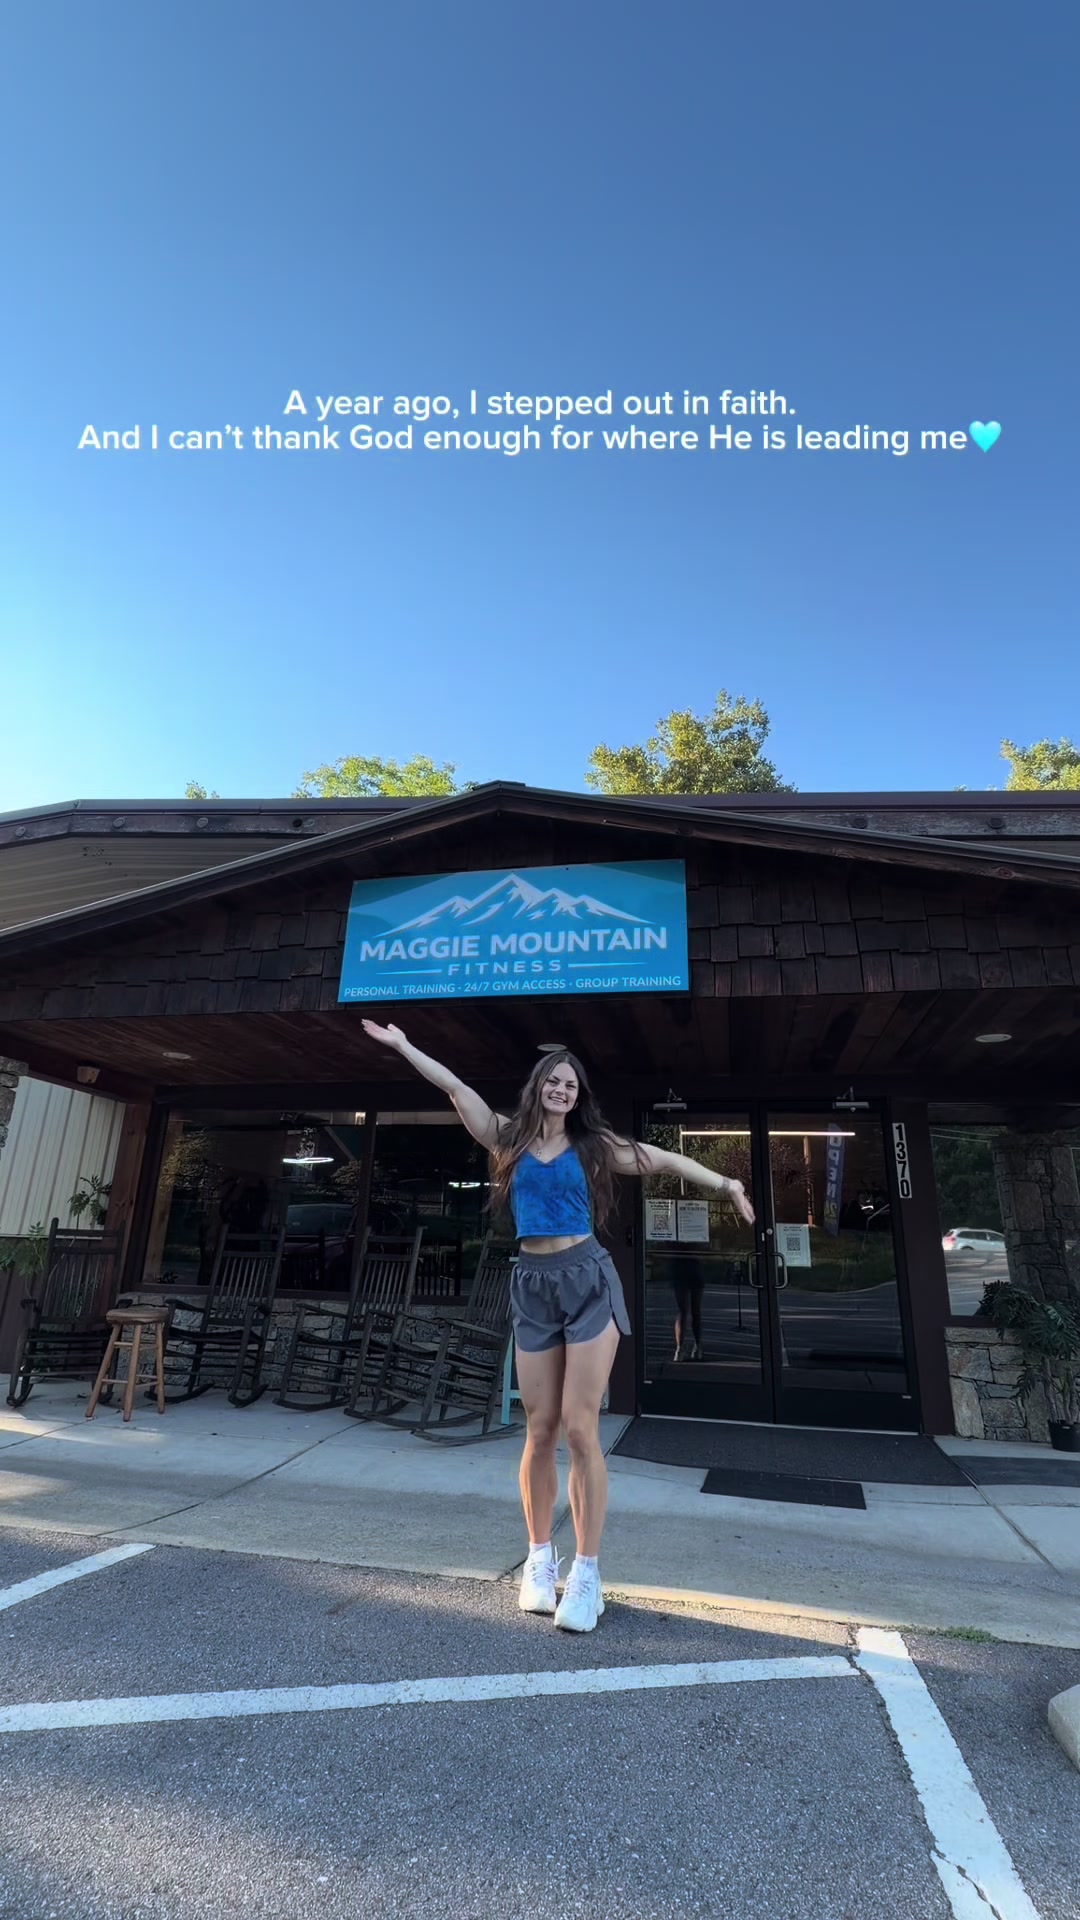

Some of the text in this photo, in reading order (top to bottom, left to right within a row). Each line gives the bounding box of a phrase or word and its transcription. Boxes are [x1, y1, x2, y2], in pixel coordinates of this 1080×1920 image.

[360, 927, 667, 961] MAGGIE MOUNTAIN
[448, 960, 562, 976] FITNESS
[344, 976, 681, 997] PERSONAL TRAINING 24/7 GYM ACCESS GROUP TRAINING
[895, 1124, 911, 1197] 1370
